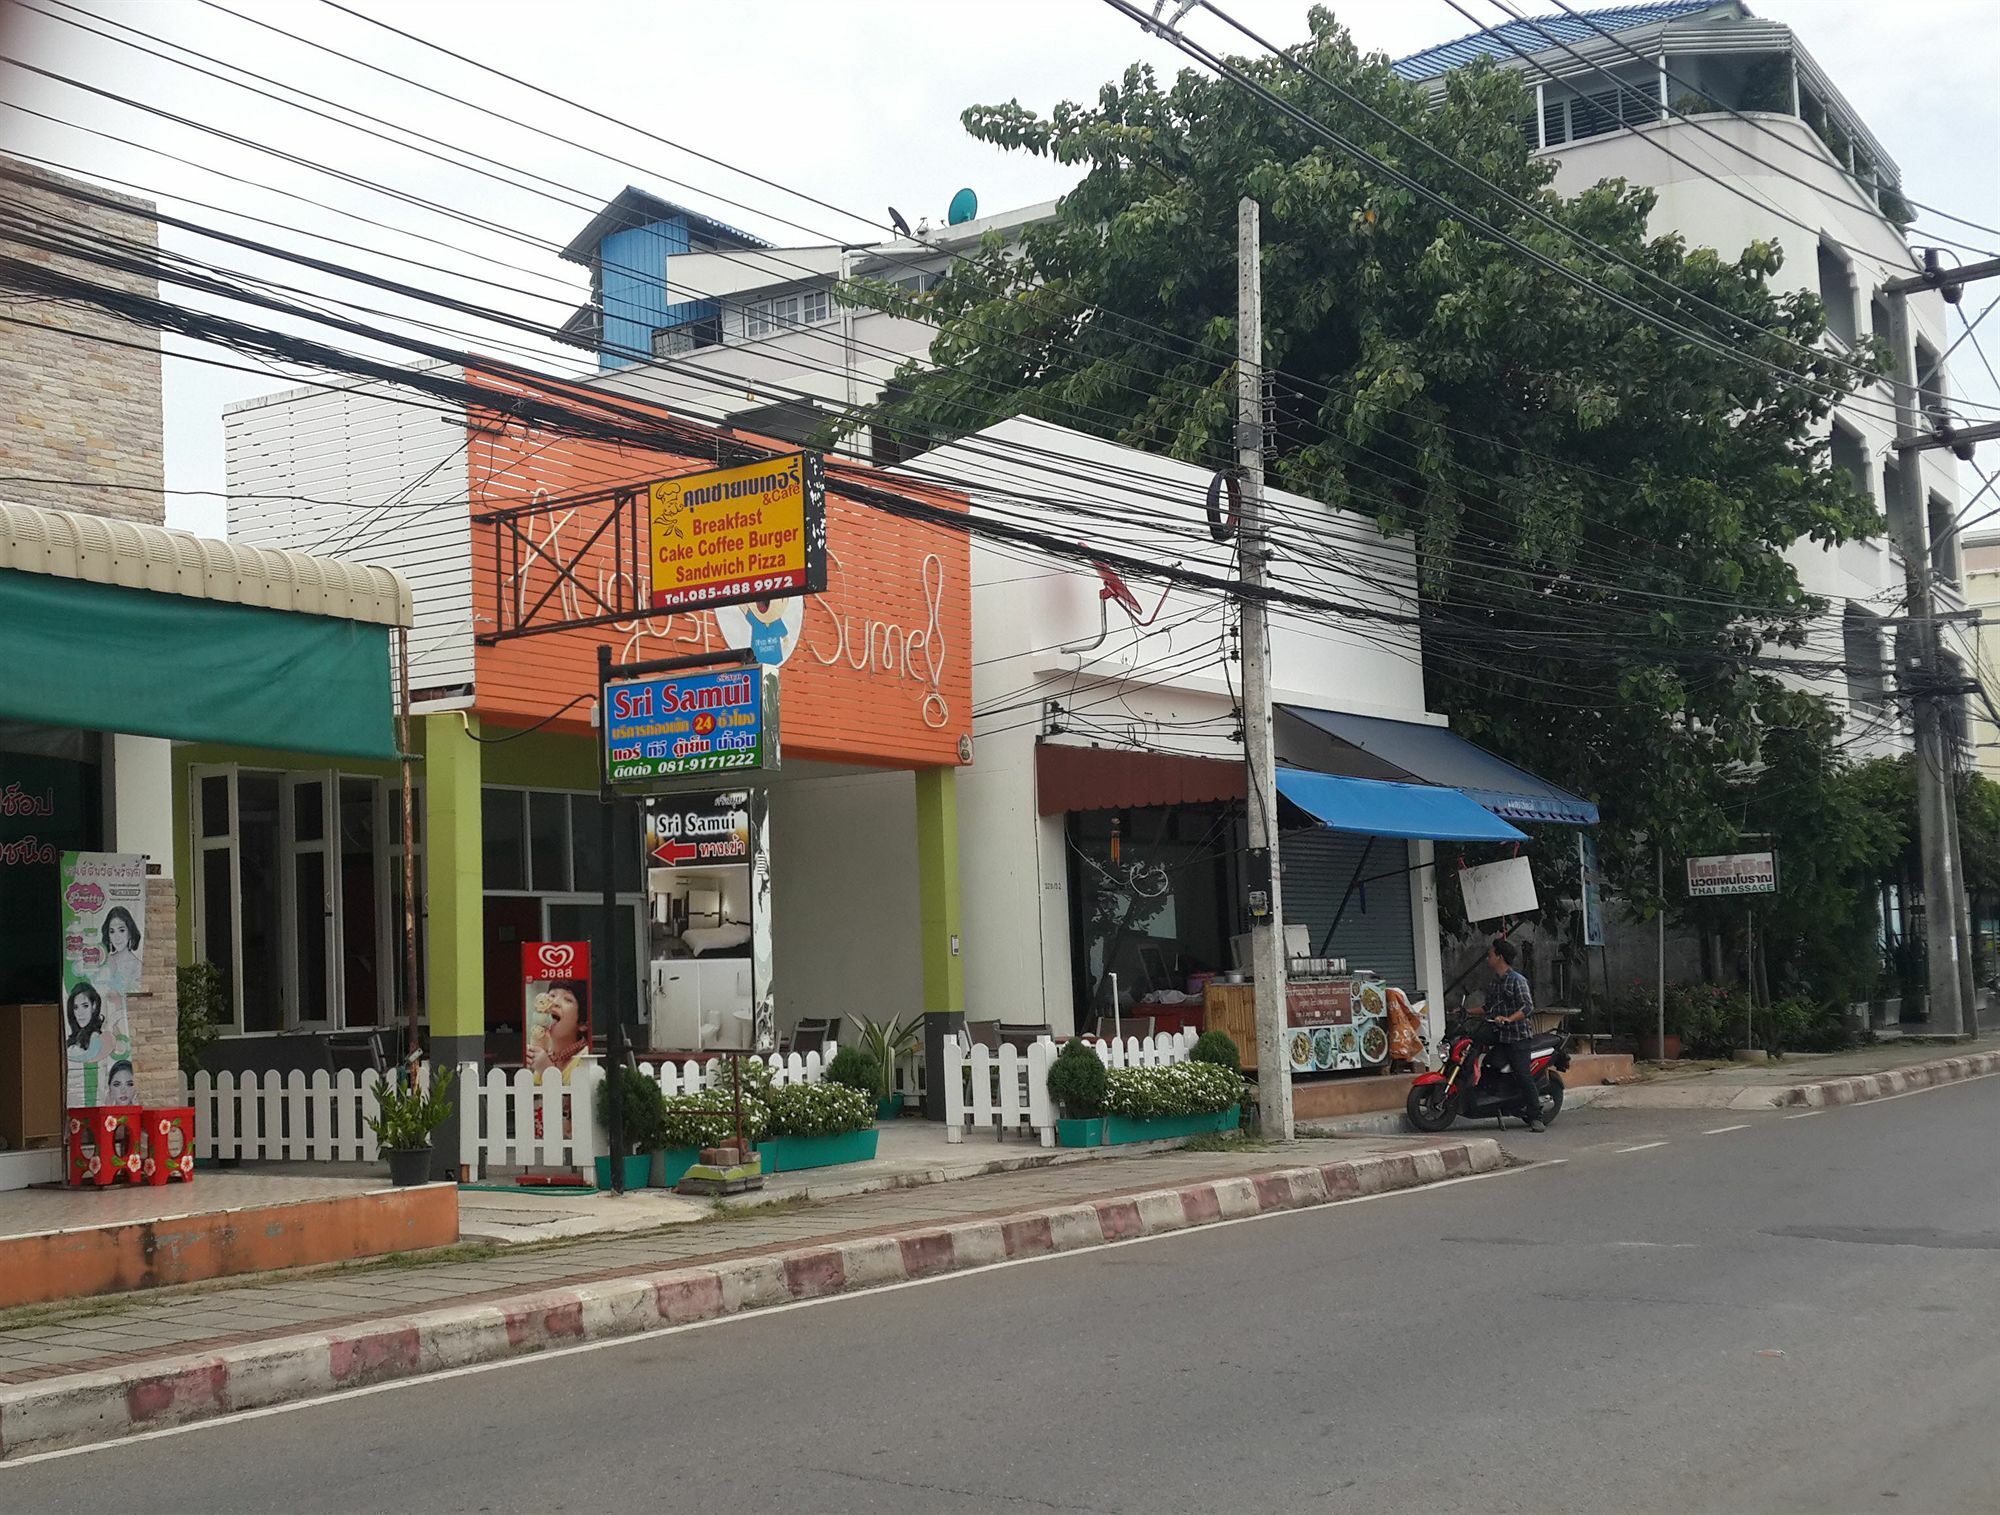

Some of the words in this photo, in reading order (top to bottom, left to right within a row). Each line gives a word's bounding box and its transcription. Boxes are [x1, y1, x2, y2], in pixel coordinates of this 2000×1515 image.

[692, 508, 763, 537] Breakfast
[659, 543, 694, 563] Cake
[697, 535, 745, 557] Coffee
[748, 527, 799, 549] Burger
[675, 557, 745, 583] Sandwich
[748, 553, 787, 571] Pizza
[665, 582, 751, 605] Tel.085-488
[753, 575, 793, 592] 9972
[614, 687, 654, 720] Sri
[661, 674, 752, 714] Samui
[694, 717, 713, 732] 24
[717, 709, 756, 728] ชั่วโมง
[612, 742, 642, 762] แอร์
[646, 739, 668, 759] ทีวี
[672, 735, 711, 759] ตู้เย็น
[716, 729, 757, 752] น้ำอุ่น
[613, 761, 652, 778] ติดต่อ
[657, 752, 756, 775] 081-9171222
[657, 815, 680, 834] Sri
[686, 812, 736, 832] Samui
[699, 833, 746, 857] ทางเข้า
[1690, 873, 1773, 888] นวดแผนโบราณ
[1691, 887, 1717, 895] THAI
[1720, 883, 1774, 894] MASSAGE
[540, 966, 573, 979] วอลล์
